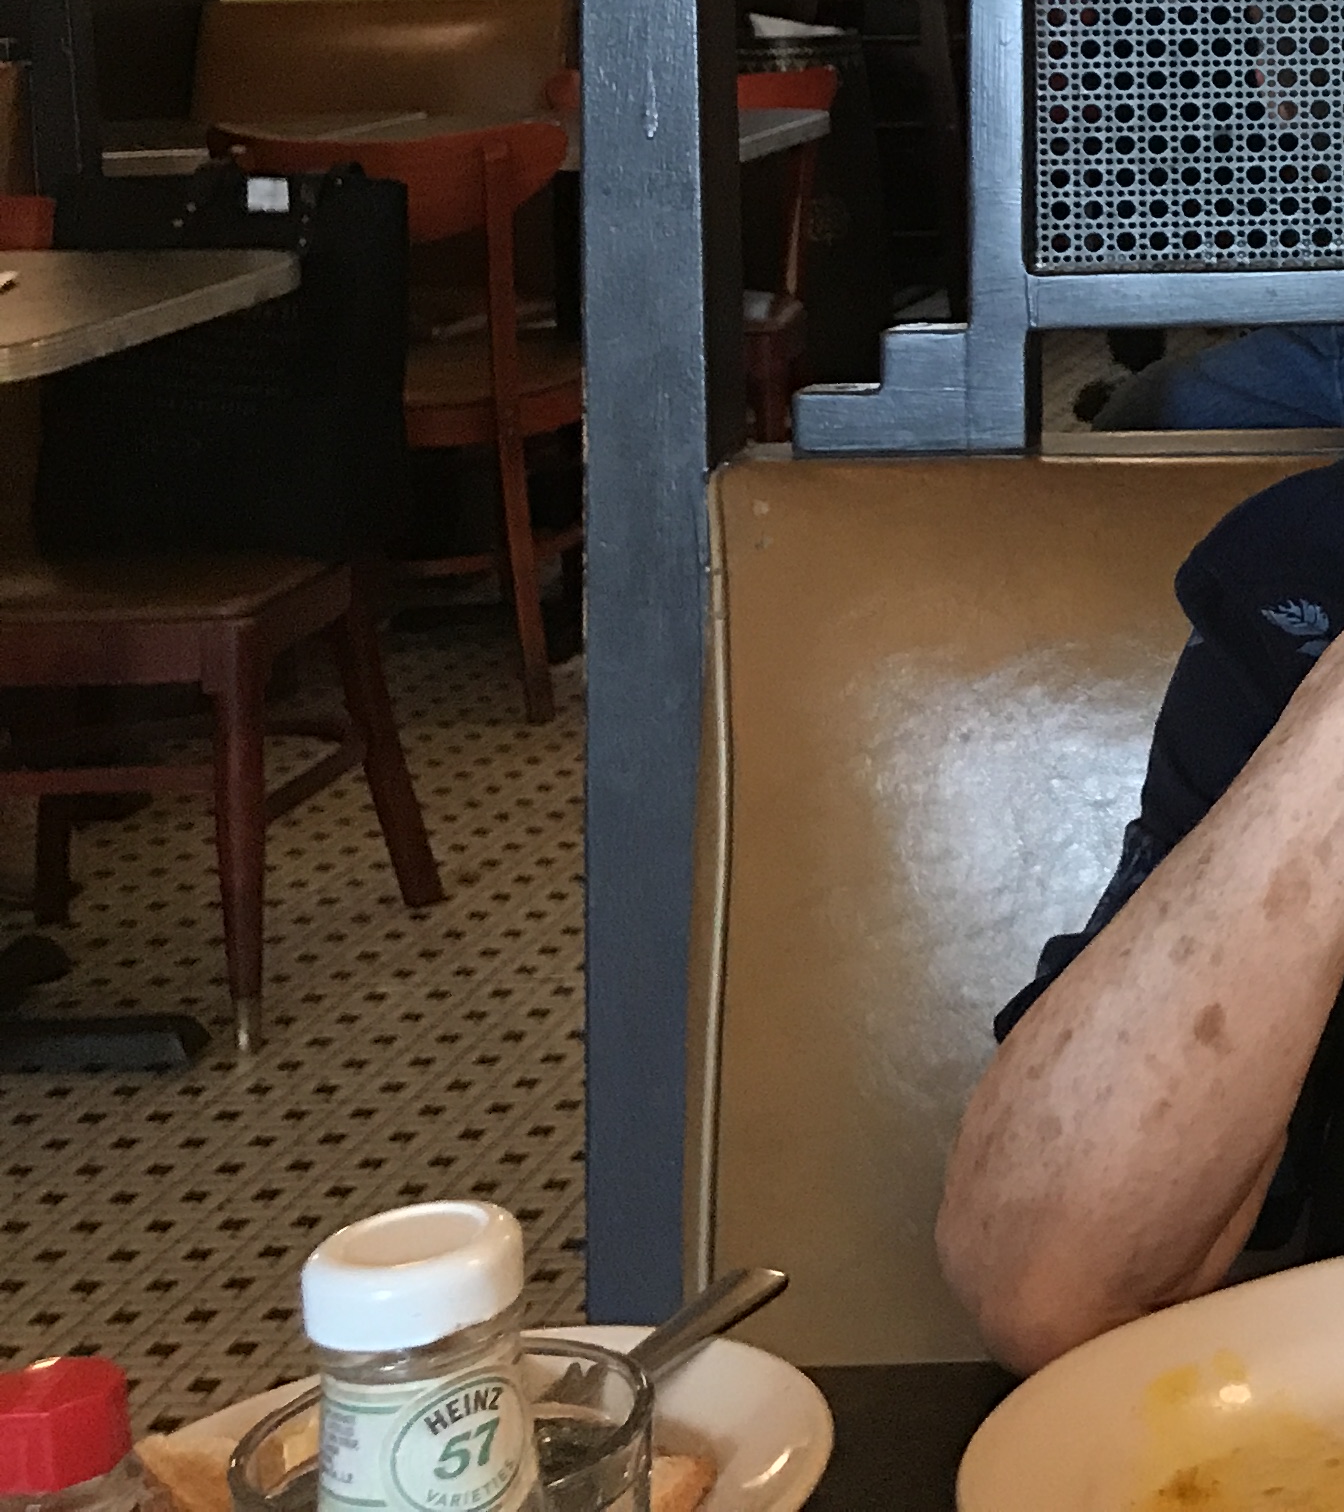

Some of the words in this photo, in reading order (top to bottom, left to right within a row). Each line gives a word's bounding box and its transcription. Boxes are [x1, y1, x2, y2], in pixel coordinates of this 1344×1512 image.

[424, 1387, 503, 1435] HEINZ
[434, 1416, 500, 1479] 57
[426, 1459, 514, 1506] VARIETIES
